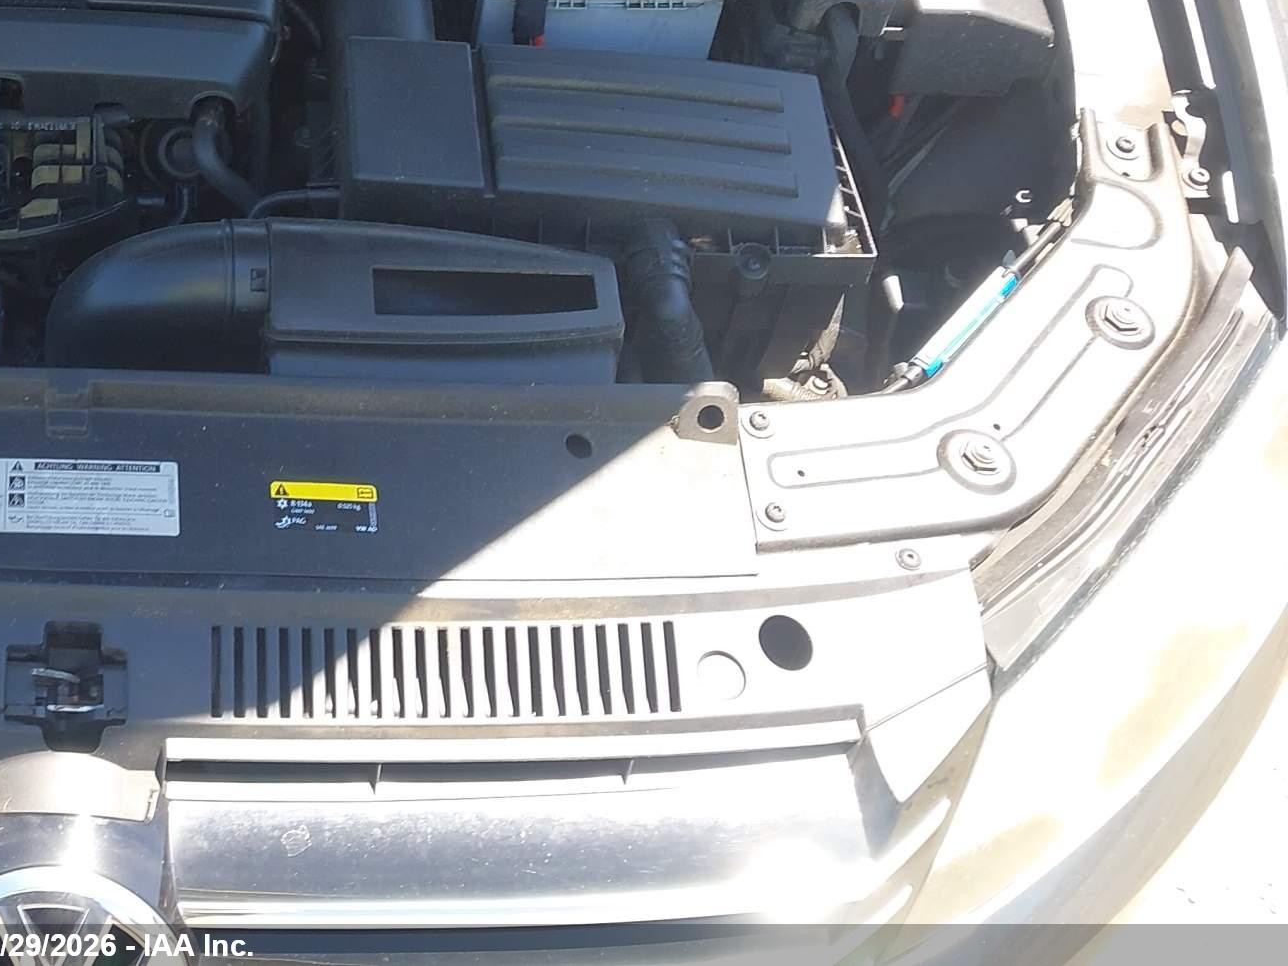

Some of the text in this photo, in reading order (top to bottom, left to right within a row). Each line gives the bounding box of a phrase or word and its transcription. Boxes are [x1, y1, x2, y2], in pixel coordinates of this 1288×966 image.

[37, 462, 157, 472] ACHTUNG WARNING ATTENTION
